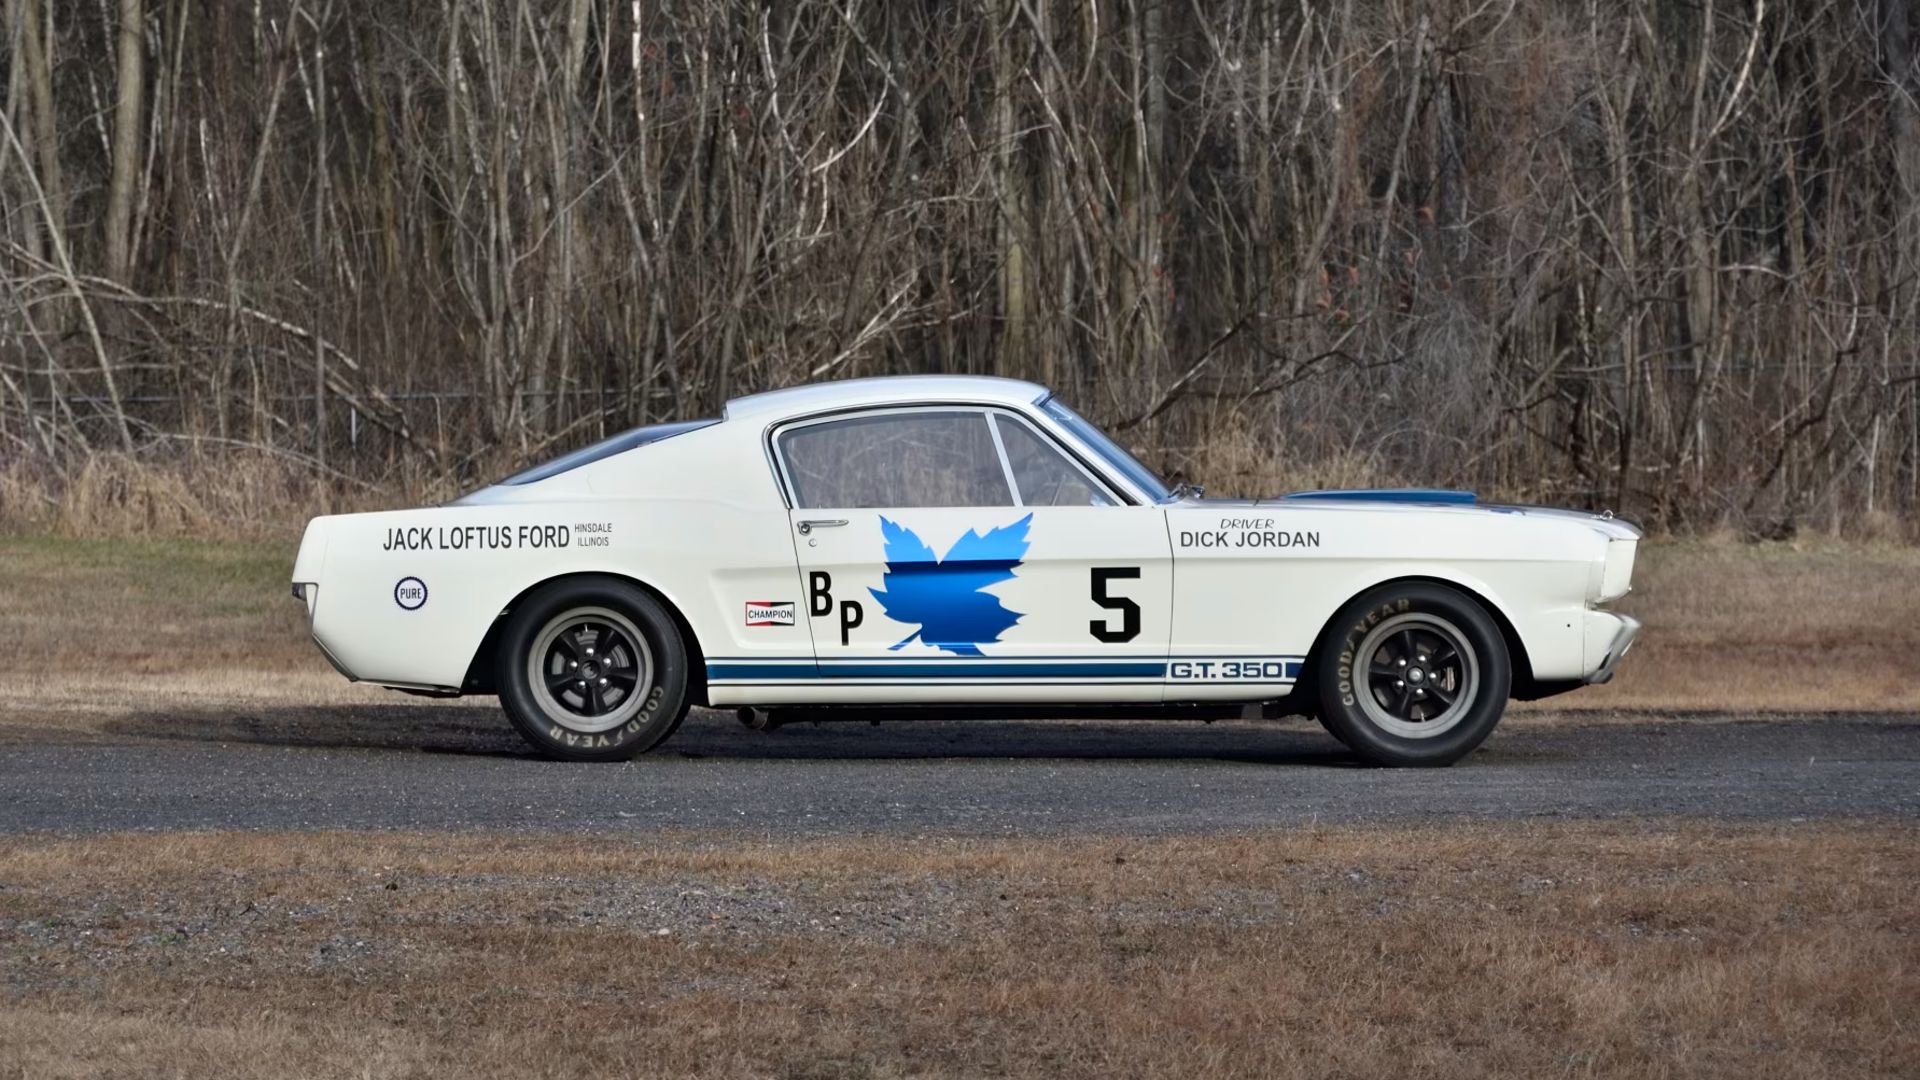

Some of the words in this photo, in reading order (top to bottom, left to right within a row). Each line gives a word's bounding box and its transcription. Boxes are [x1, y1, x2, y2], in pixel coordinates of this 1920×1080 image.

[574, 523, 613, 533] HINSDALE
[1220, 518, 1275, 530] DRIVER
[383, 527, 433, 551] JACK
[439, 526, 512, 550] LOFTUS
[518, 525, 570, 548] FORD
[577, 536, 610, 547] ILLINOIS
[1180, 531, 1229, 547] DICK
[1235, 531, 1320, 548] JORDAN
[400, 587, 422, 600] PURE
[1089, 567, 1141, 643] 5
[748, 609, 793, 619] CHAMPION
[1222, 662, 1283, 679] 350
